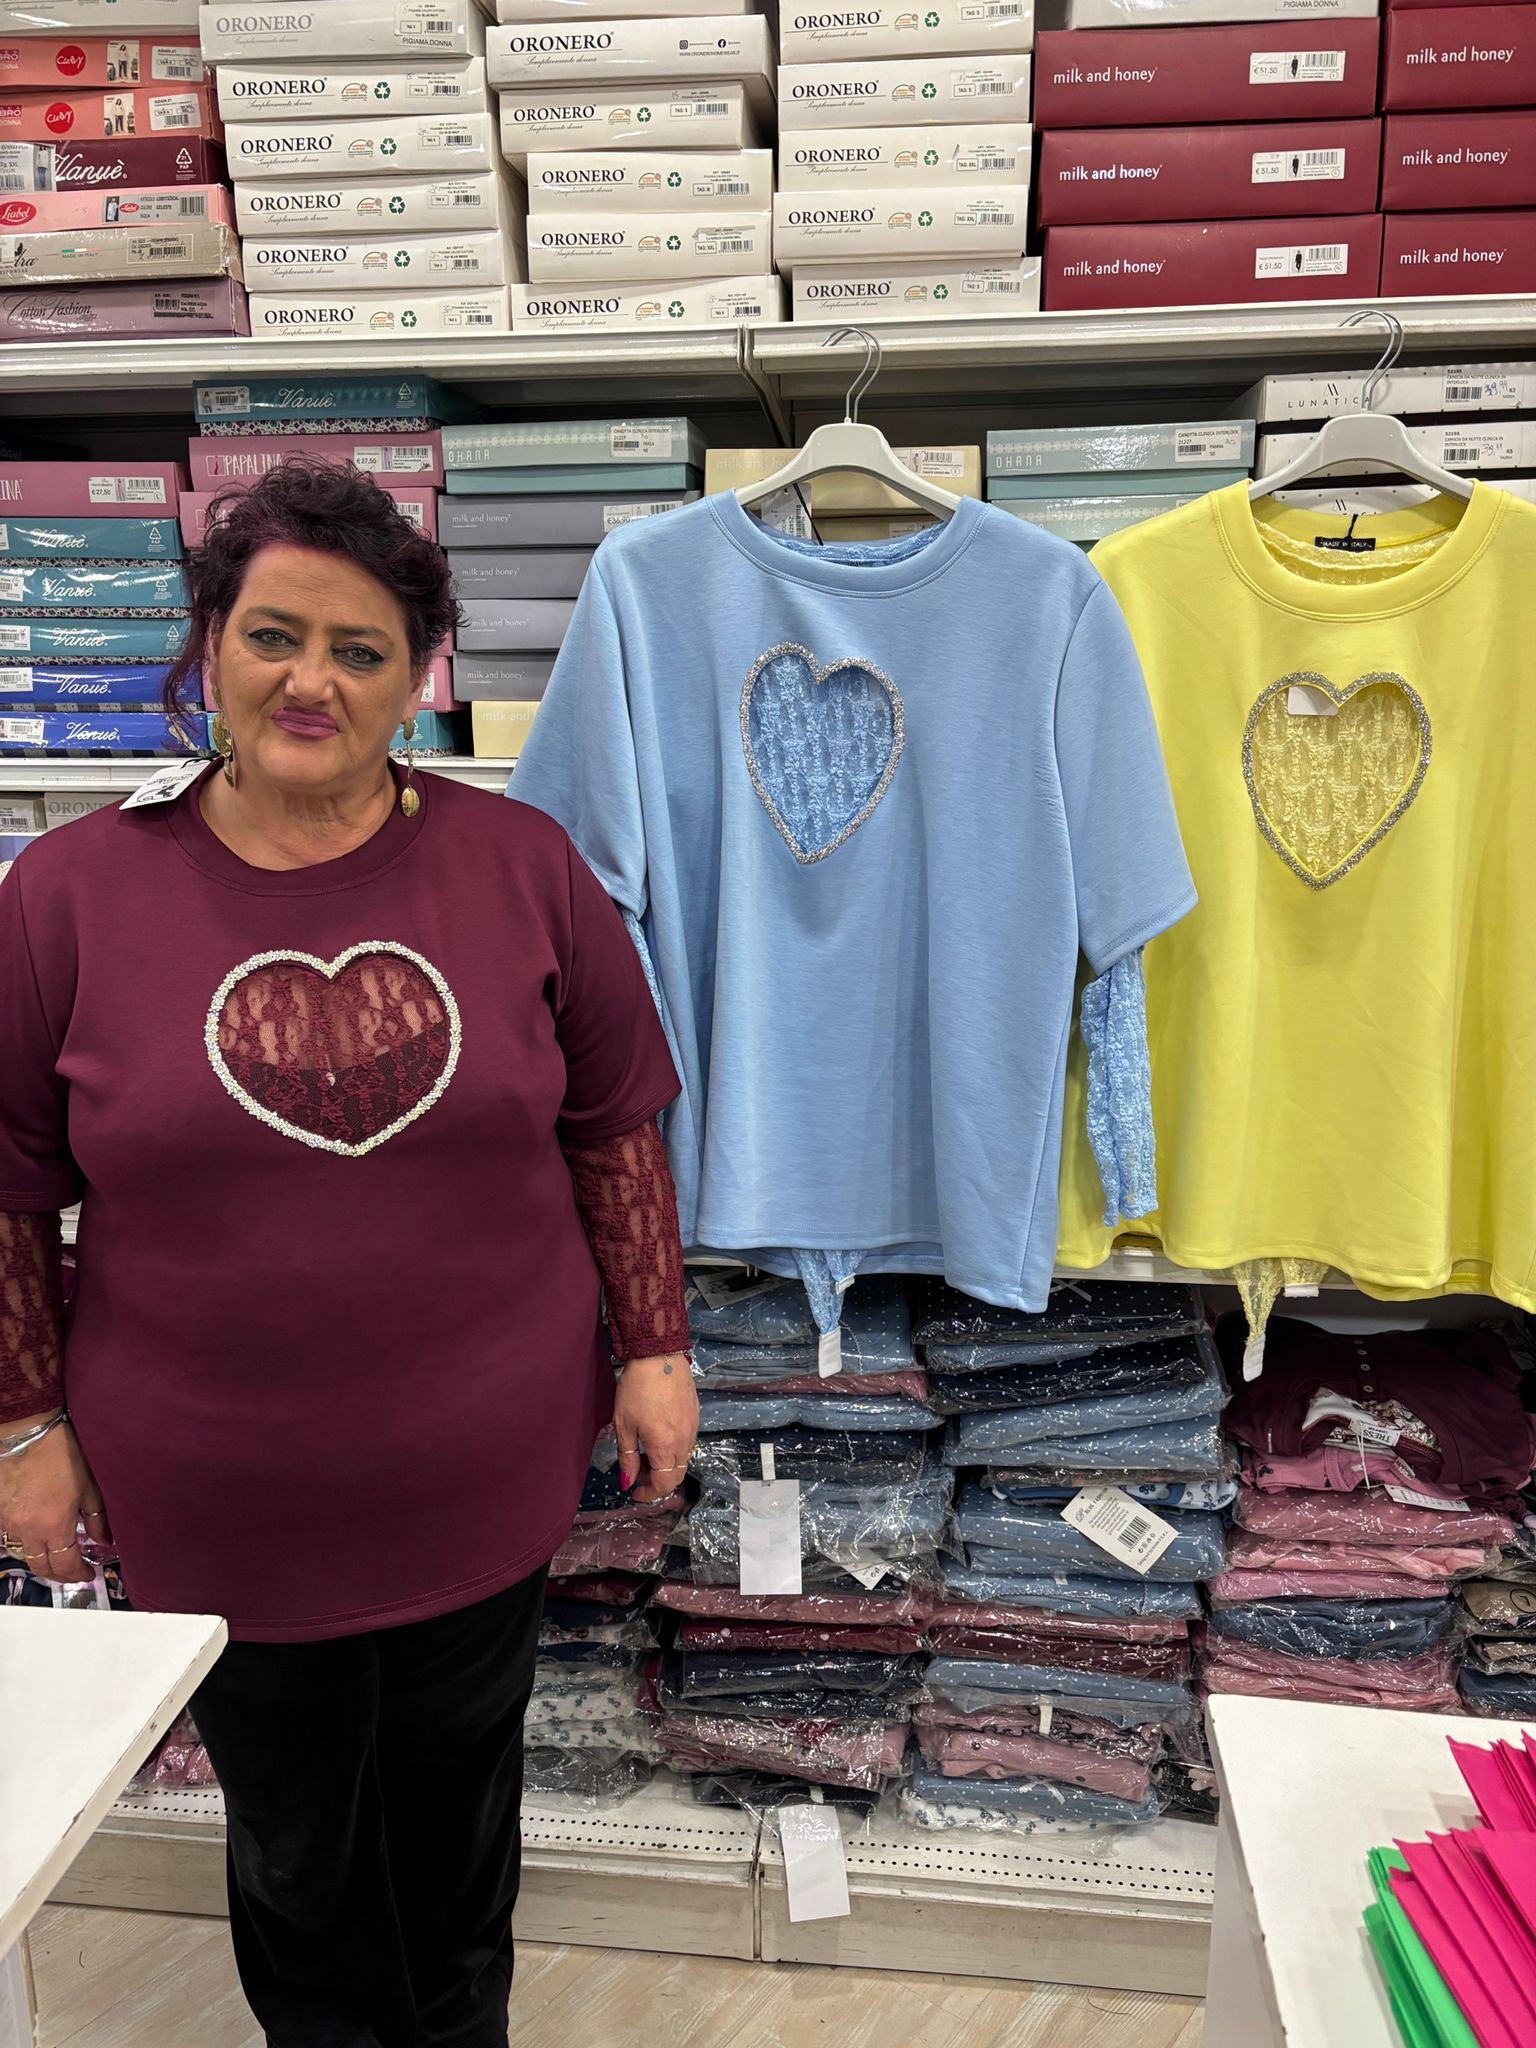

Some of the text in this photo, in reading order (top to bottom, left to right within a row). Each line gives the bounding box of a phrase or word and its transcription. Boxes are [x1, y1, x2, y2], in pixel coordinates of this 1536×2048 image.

[1283, 0, 1339, 8] PIGIAMA DONNA
[216, 14, 312, 33] ORONERO
[794, 11, 880, 30] ORONERO
[402, 37, 453, 47] PIGIAMA DONNA
[510, 33, 611, 53] ORONERO
[1406, 45, 1514, 65] milk and honey
[1053, 66, 1156, 86] milk and honey
[232, 79, 326, 97] ORONERO
[792, 81, 878, 99] ORONERO
[514, 105, 595, 123] ORONERO
[241, 135, 332, 155] ORONERO
[795, 148, 880, 164] ORONERO
[1402, 147, 1508, 166] milk and honey
[55, 153, 125, 184] Vanuè
[542, 169, 625, 184] ORONERO
[1059, 164, 1160, 182] milk and honey
[2, 203, 31, 222] Liabel
[250, 194, 341, 213] ORONERO
[788, 209, 874, 225] ORONERO
[541, 231, 624, 246] ORONERO
[257, 247, 347, 264] ORONERO
[1399, 247, 1505, 265] milk and honey
[1063, 258, 1164, 277] milk and honey
[807, 282, 890, 299] ORONERO
[3, 290, 91, 326] Cotton Fashion
[264, 307, 354, 325] ORONERO
[527, 298, 620, 316] ORONERO
[278, 388, 334, 409] Vanuè
[1287, 396, 1372, 409] LUNATICA
[448, 450, 490, 463] OHANA
[995, 455, 1042, 469] OHANA
[452, 513, 509, 524] milk and honey
[462, 567, 518, 577] milk and honey
[467, 670, 523, 680] milk and honey
[56, 675, 110, 694] Vanuè
